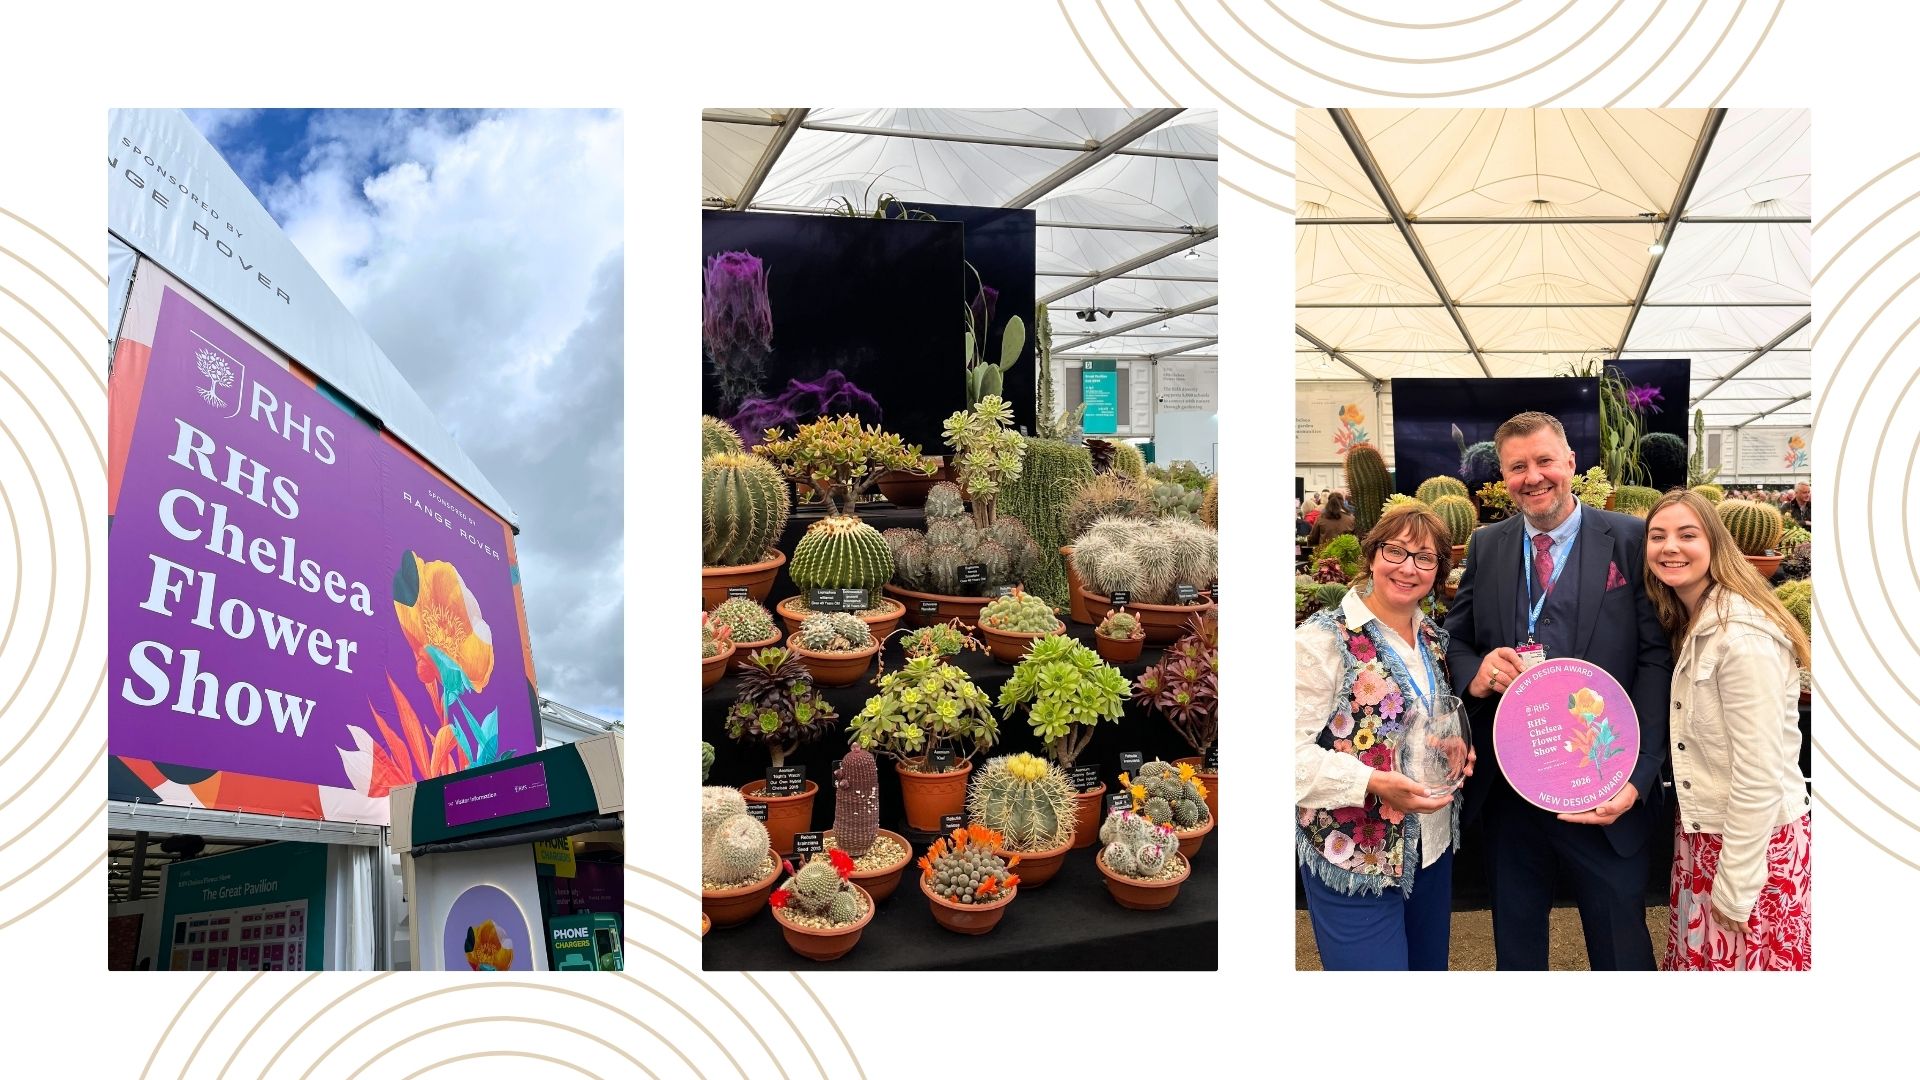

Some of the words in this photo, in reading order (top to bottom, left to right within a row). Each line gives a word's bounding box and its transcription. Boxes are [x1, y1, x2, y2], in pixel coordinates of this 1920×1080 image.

[121, 136, 219, 220] SPONSORED
[226, 222, 243, 238] BY
[192, 220, 291, 304] ROVER
[250, 381, 336, 465] RHS
[168, 417, 299, 520] RHS
[428, 489, 467, 520] SPONSORED
[403, 491, 452, 530] RANGE
[460, 528, 500, 561] ROVER
[158, 488, 374, 616] Chelsea
[139, 553, 358, 674] Flower
[121, 640, 317, 738] Show
[1515, 678, 1532, 696] NEW
[1532, 665, 1562, 681] DESIGN
[1563, 665, 1593, 678] AWARD
[1527, 716, 1547, 729] RHS
[1533, 702, 1550, 714] RHS
[1529, 723, 1563, 738] Chelsea
[1531, 733, 1562, 748] Flower
[1533, 744, 1558, 757] Show
[1538, 791, 1561, 806] NEW
[1563, 794, 1597, 807] DESIGN
[1598, 770, 1624, 799] AWARD
[1570, 775, 1592, 788] 2026
[202, 888, 218, 901] The
[218, 885, 242, 899] Great
[243, 878, 278, 895] Pavilion
[553, 927, 589, 939] PHONE
[555, 939, 591, 949] CHARGERS
